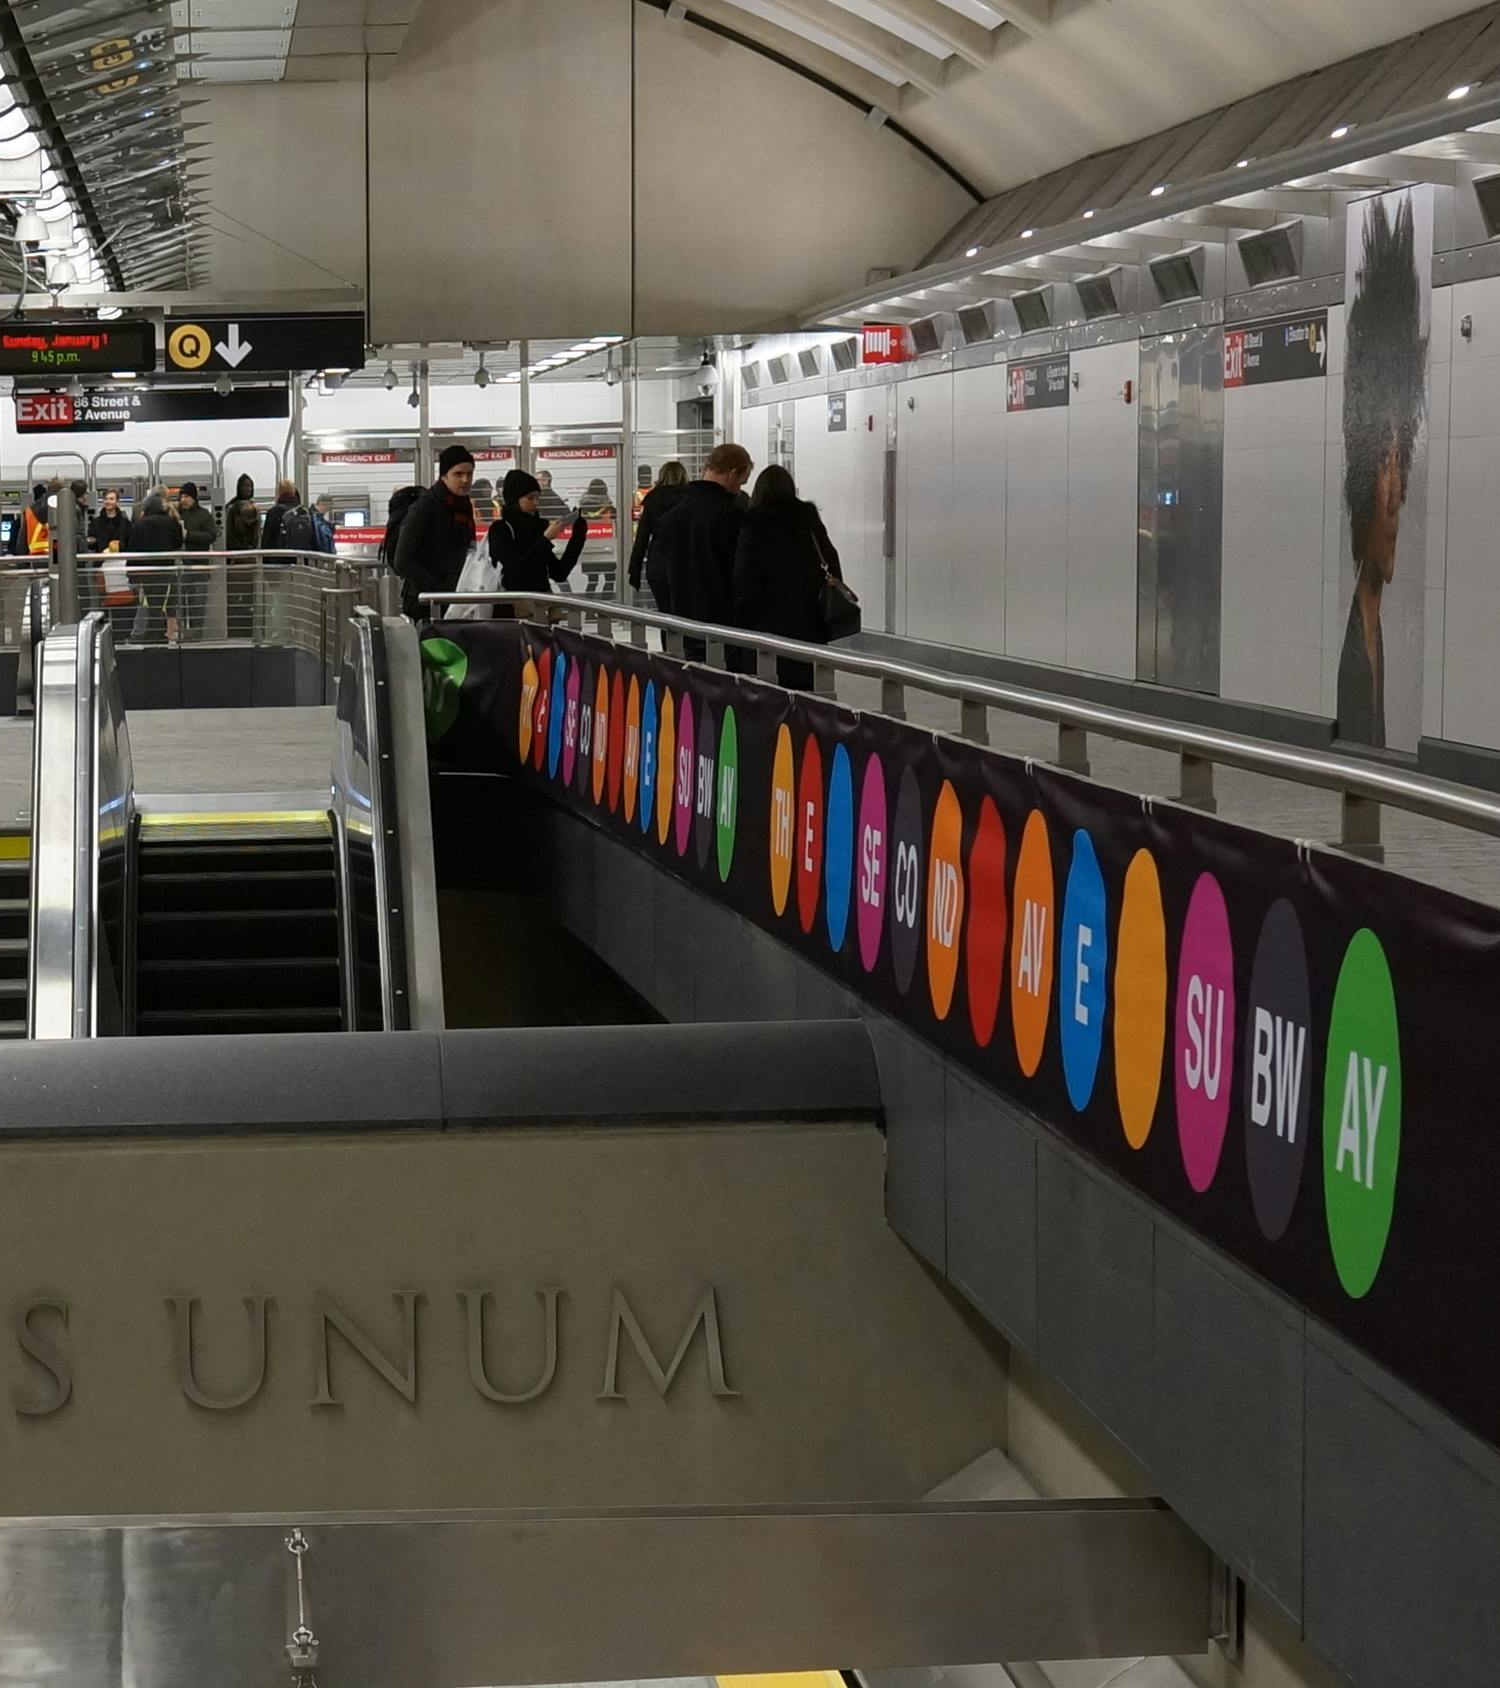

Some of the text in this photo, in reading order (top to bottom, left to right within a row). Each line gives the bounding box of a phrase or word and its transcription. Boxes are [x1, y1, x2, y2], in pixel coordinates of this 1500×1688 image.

[52, 334, 100, 349] January
[102, 332, 108, 346] 1
[178, 333, 201, 359] Q
[56, 352, 81, 365] p.m.
[1224, 335, 1242, 379] Exit
[16, 397, 68, 422] Exit
[91, 395, 129, 408] Street
[131, 394, 142, 407] &
[73, 409, 131, 421] 2 Avenue
[325, 453, 392, 463] EMERGENCY EXIT
[542, 449, 609, 459] EMERGENCY EXIT
[645, 731, 652, 786] E
[678, 745, 692, 808] SU
[697, 754, 715, 819] BW
[719, 764, 735, 829] AY
[774, 787, 1388, 1190] TH E SE CO ND AV E SU BW AY
[163, 1284, 744, 1411] UNUM
